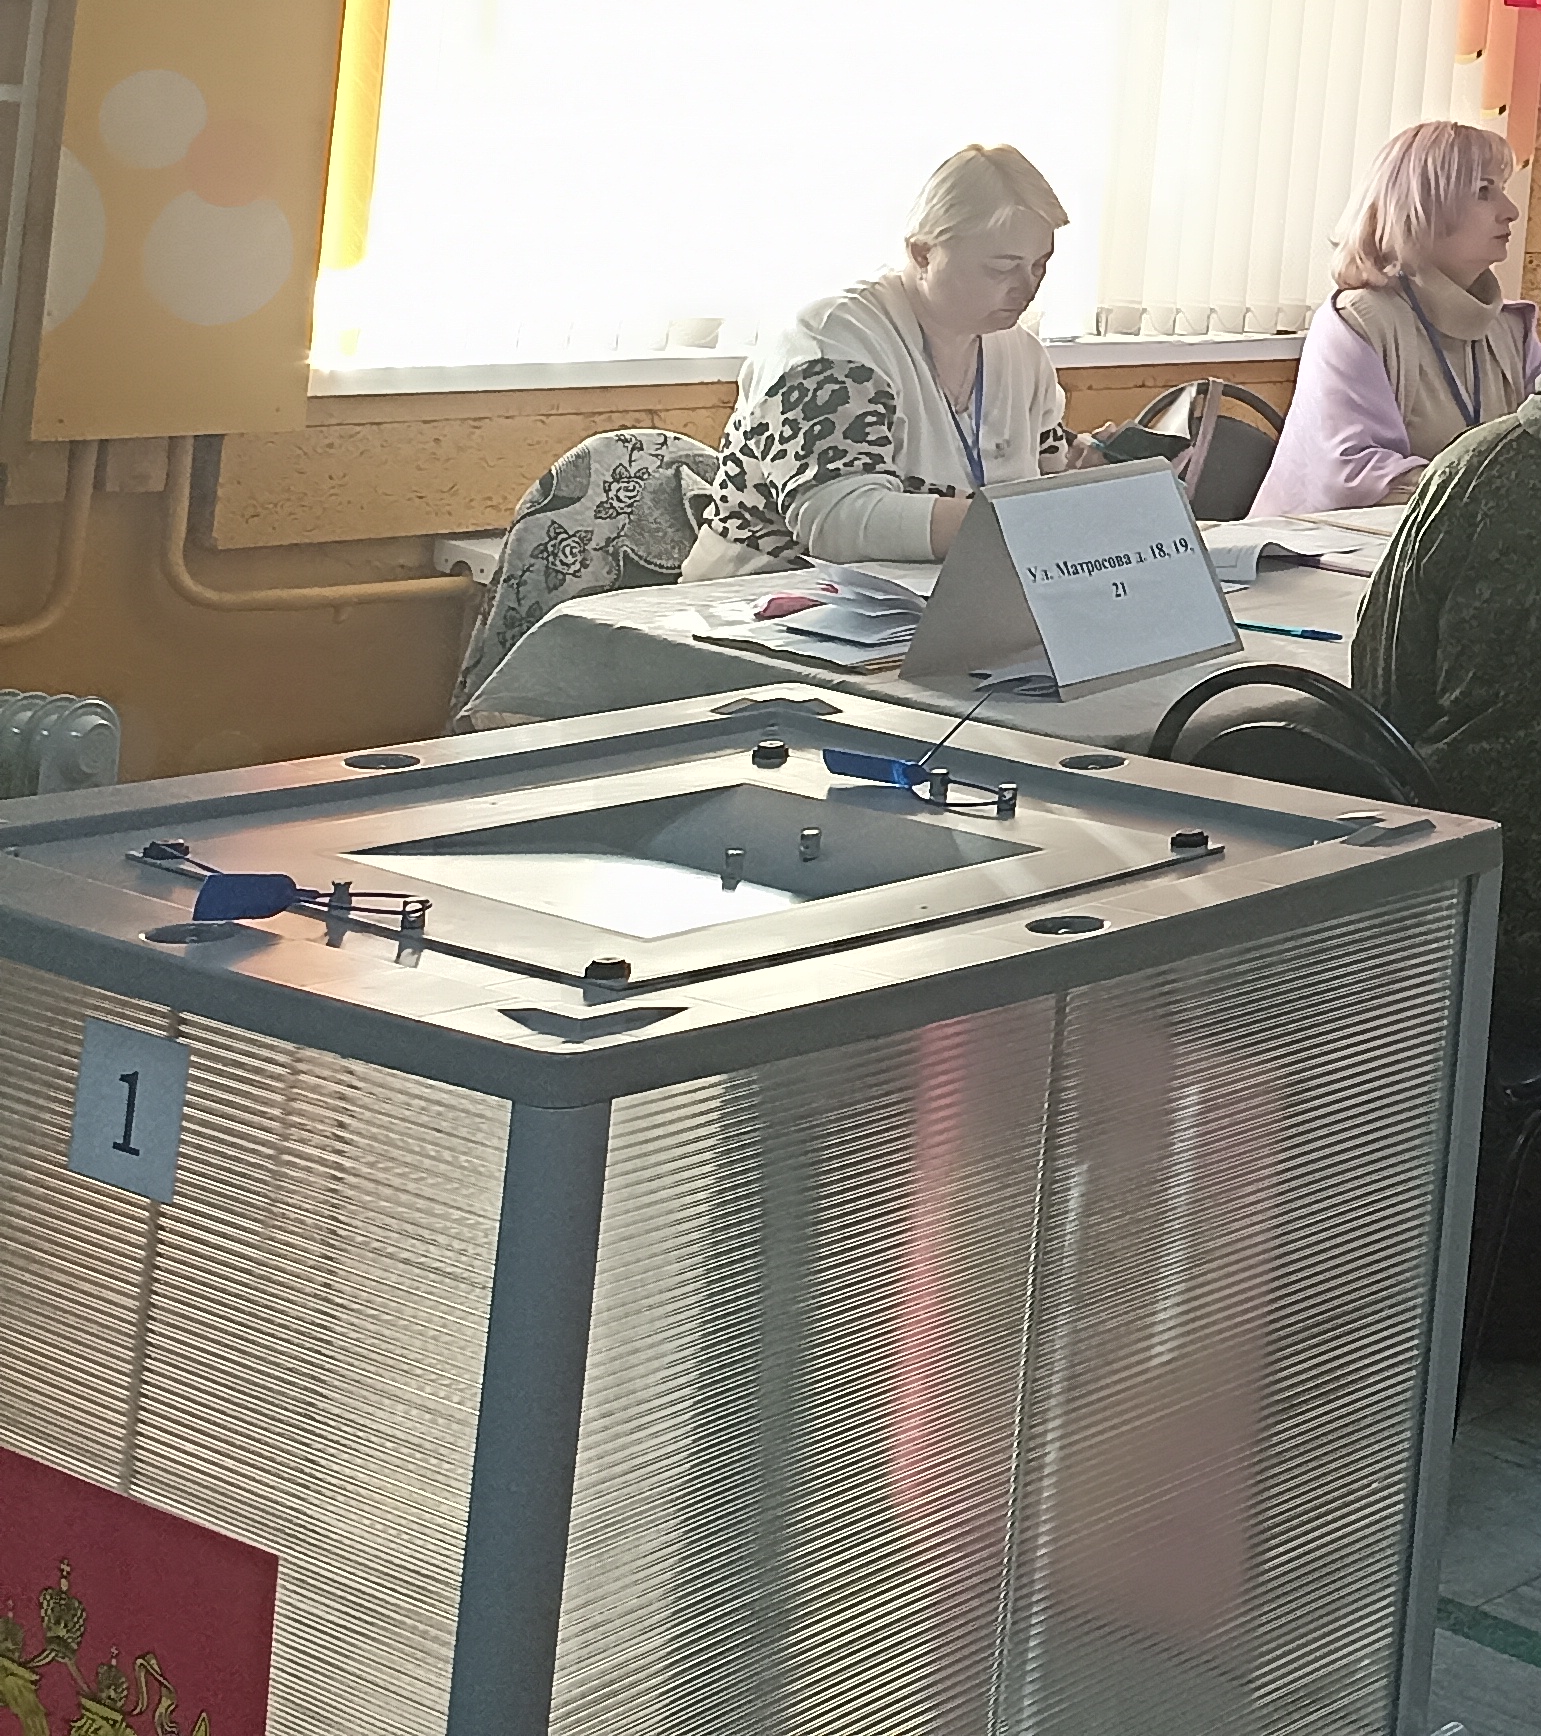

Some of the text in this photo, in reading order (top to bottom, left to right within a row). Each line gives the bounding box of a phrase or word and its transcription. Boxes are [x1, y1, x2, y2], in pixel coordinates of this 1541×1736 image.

[1026, 566, 1053, 583] Ул.
[1055, 553, 1132, 577] Матросова
[1150, 542, 1171, 559] 18,
[1112, 581, 1127, 598] 21
[112, 1070, 140, 1157] 1
